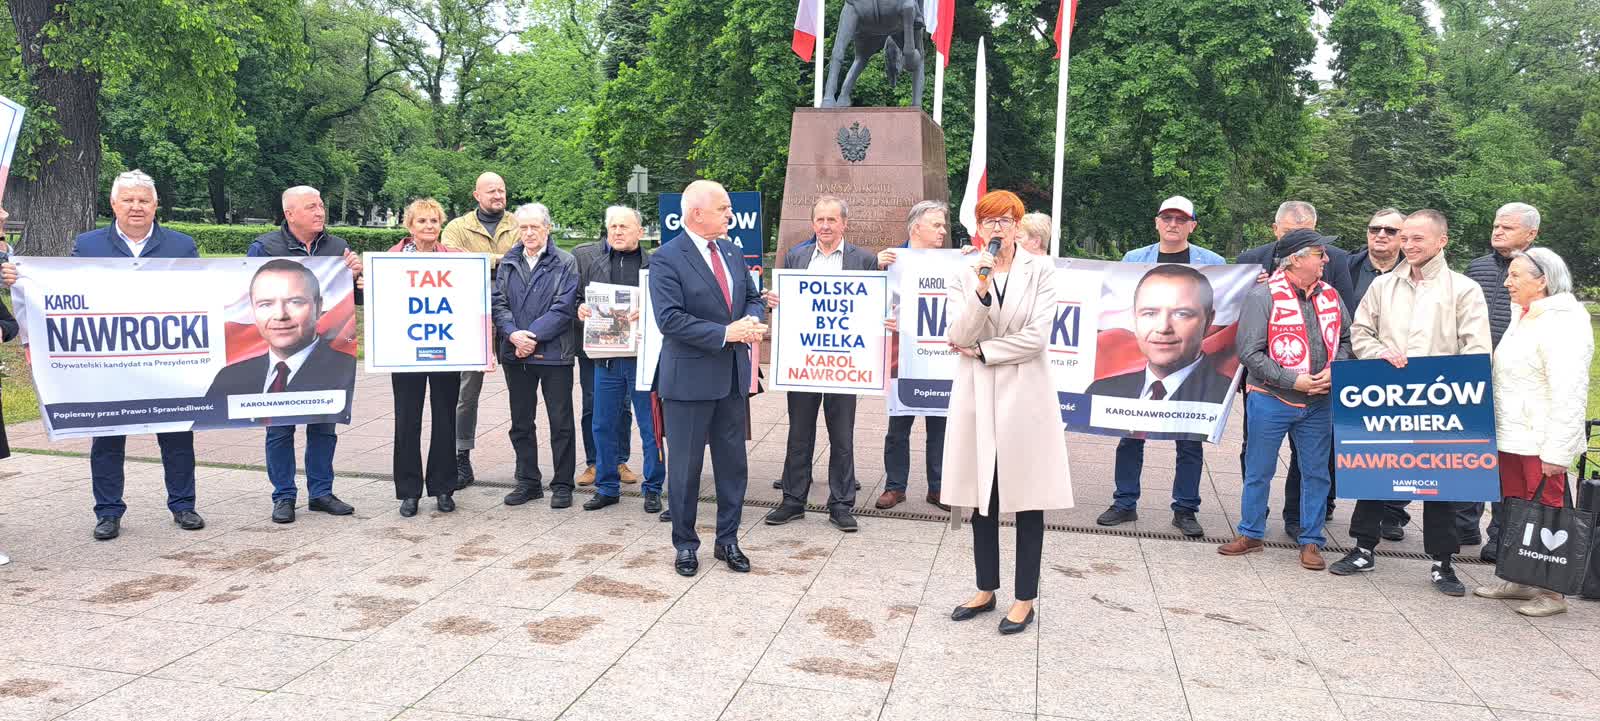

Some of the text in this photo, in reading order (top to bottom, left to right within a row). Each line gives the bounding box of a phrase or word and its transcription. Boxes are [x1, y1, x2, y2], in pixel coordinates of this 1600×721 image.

[406, 270, 453, 288] TAK
[918, 277, 947, 289] KAROL
[799, 281, 868, 296] POLSKA
[45, 294, 89, 310] KAROL
[408, 297, 453, 314] DLA
[812, 298, 854, 313] MUSI
[816, 313, 850, 330] BYĆ
[46, 315, 209, 352] NAWROCKI
[407, 323, 455, 341] CPK
[800, 333, 865, 348] WIELKA
[51, 361, 102, 370] Obywatelski
[104, 360, 141, 369] kandydat
[154, 359, 199, 368] Prezydenta
[805, 353, 855, 368] KAROL
[788, 367, 872, 382] NAWROCKI
[1339, 375, 1486, 408] GORZÓW
[240, 398, 334, 408] KAROLNAWROCKI2025.pl
[53, 411, 95, 419] Popierany
[153, 404, 214, 414] Sprawiedliwość
[1105, 407, 1217, 422] KAROLNAWROCKI2025.pl
[1363, 414, 1464, 432] WYBIERA
[1337, 453, 1497, 470] NAWROCKIEGO
[1522, 522, 1535, 546] I
[1518, 548, 1568, 565] SHOPPING
